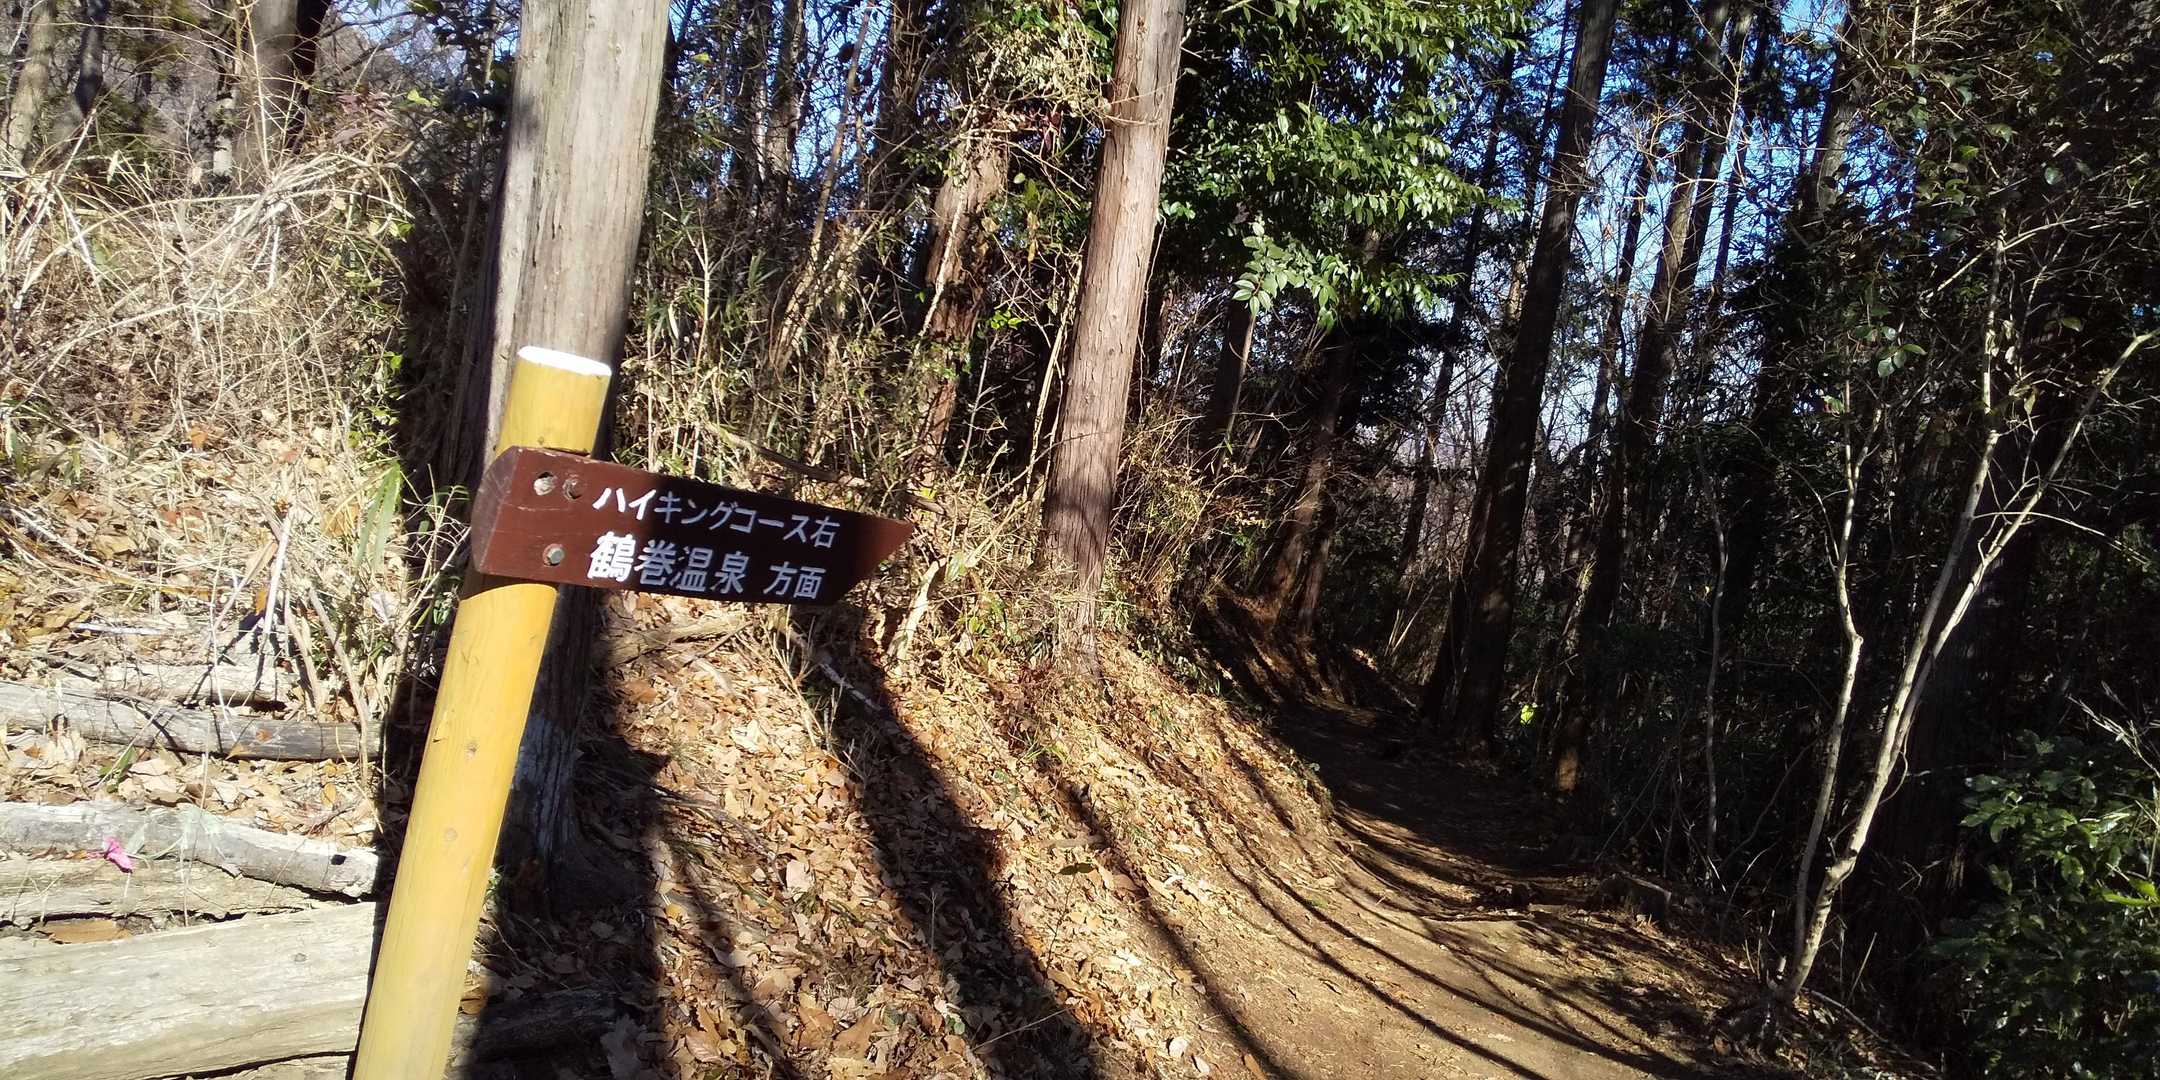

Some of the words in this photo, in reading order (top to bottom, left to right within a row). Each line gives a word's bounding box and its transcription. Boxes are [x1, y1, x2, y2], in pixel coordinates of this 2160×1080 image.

[593, 487, 841, 549] ハイキングコース右
[587, 531, 750, 595] 鶴巻温泉
[763, 561, 827, 600] 方面
